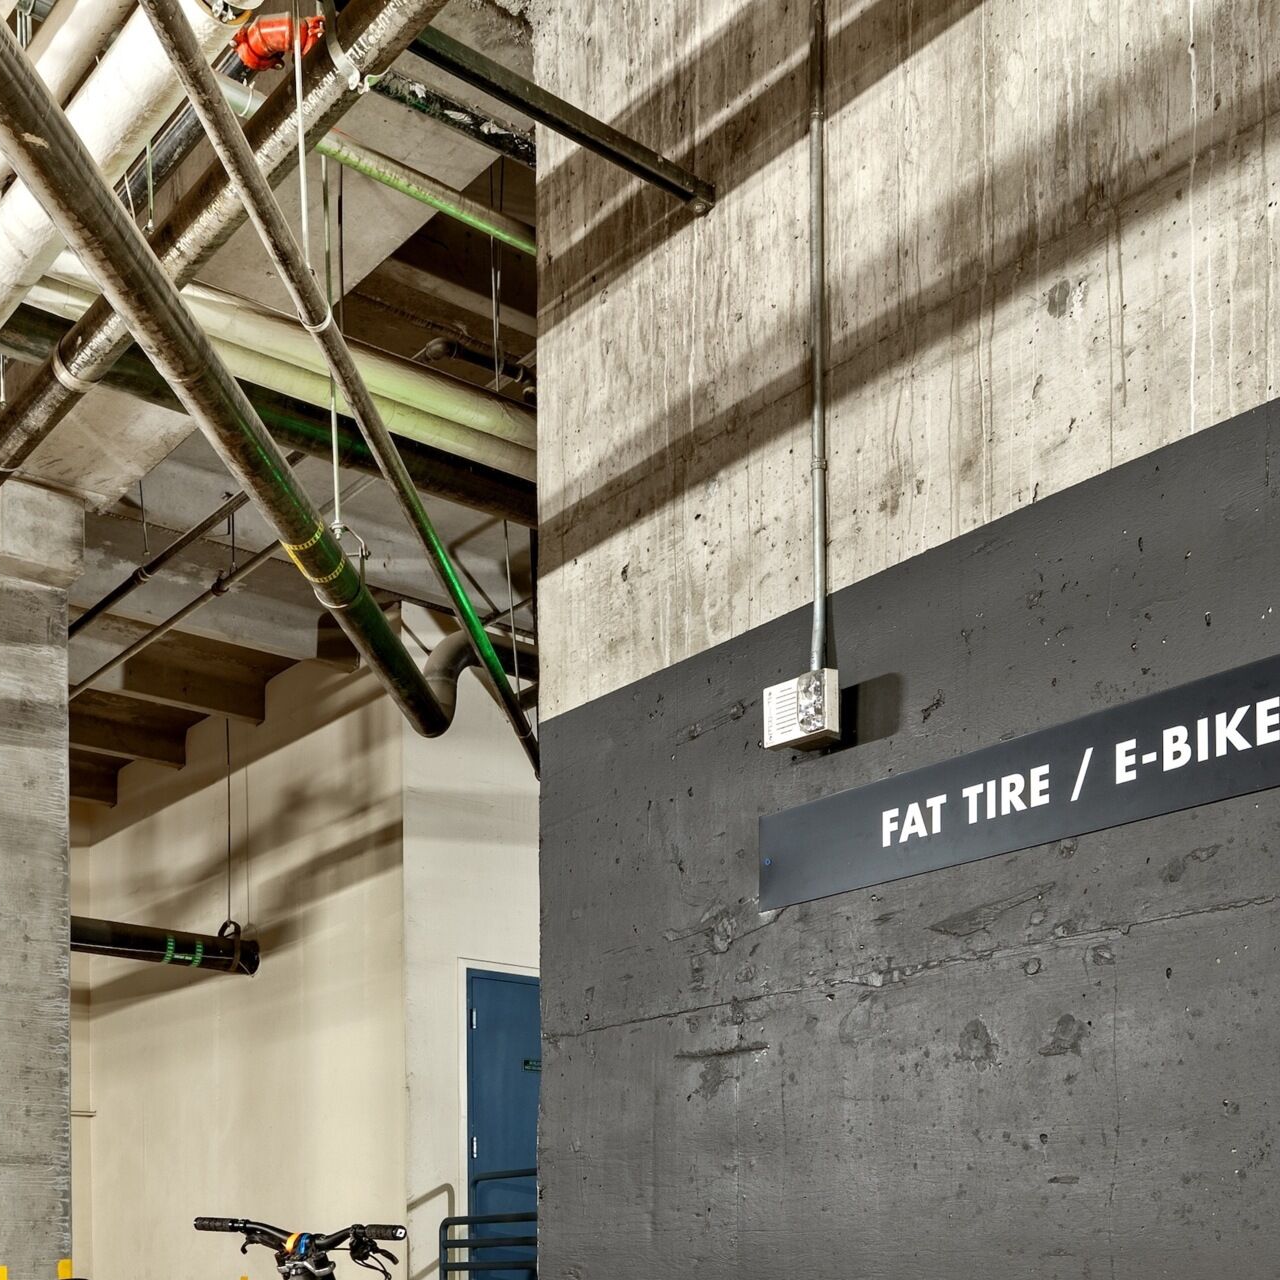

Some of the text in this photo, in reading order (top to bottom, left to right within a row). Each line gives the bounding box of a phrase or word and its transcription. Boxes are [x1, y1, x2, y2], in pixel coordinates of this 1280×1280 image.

[882, 794, 947, 848] FAT
[962, 763, 1050, 825] TIRE
[1070, 746, 1094, 802] /
